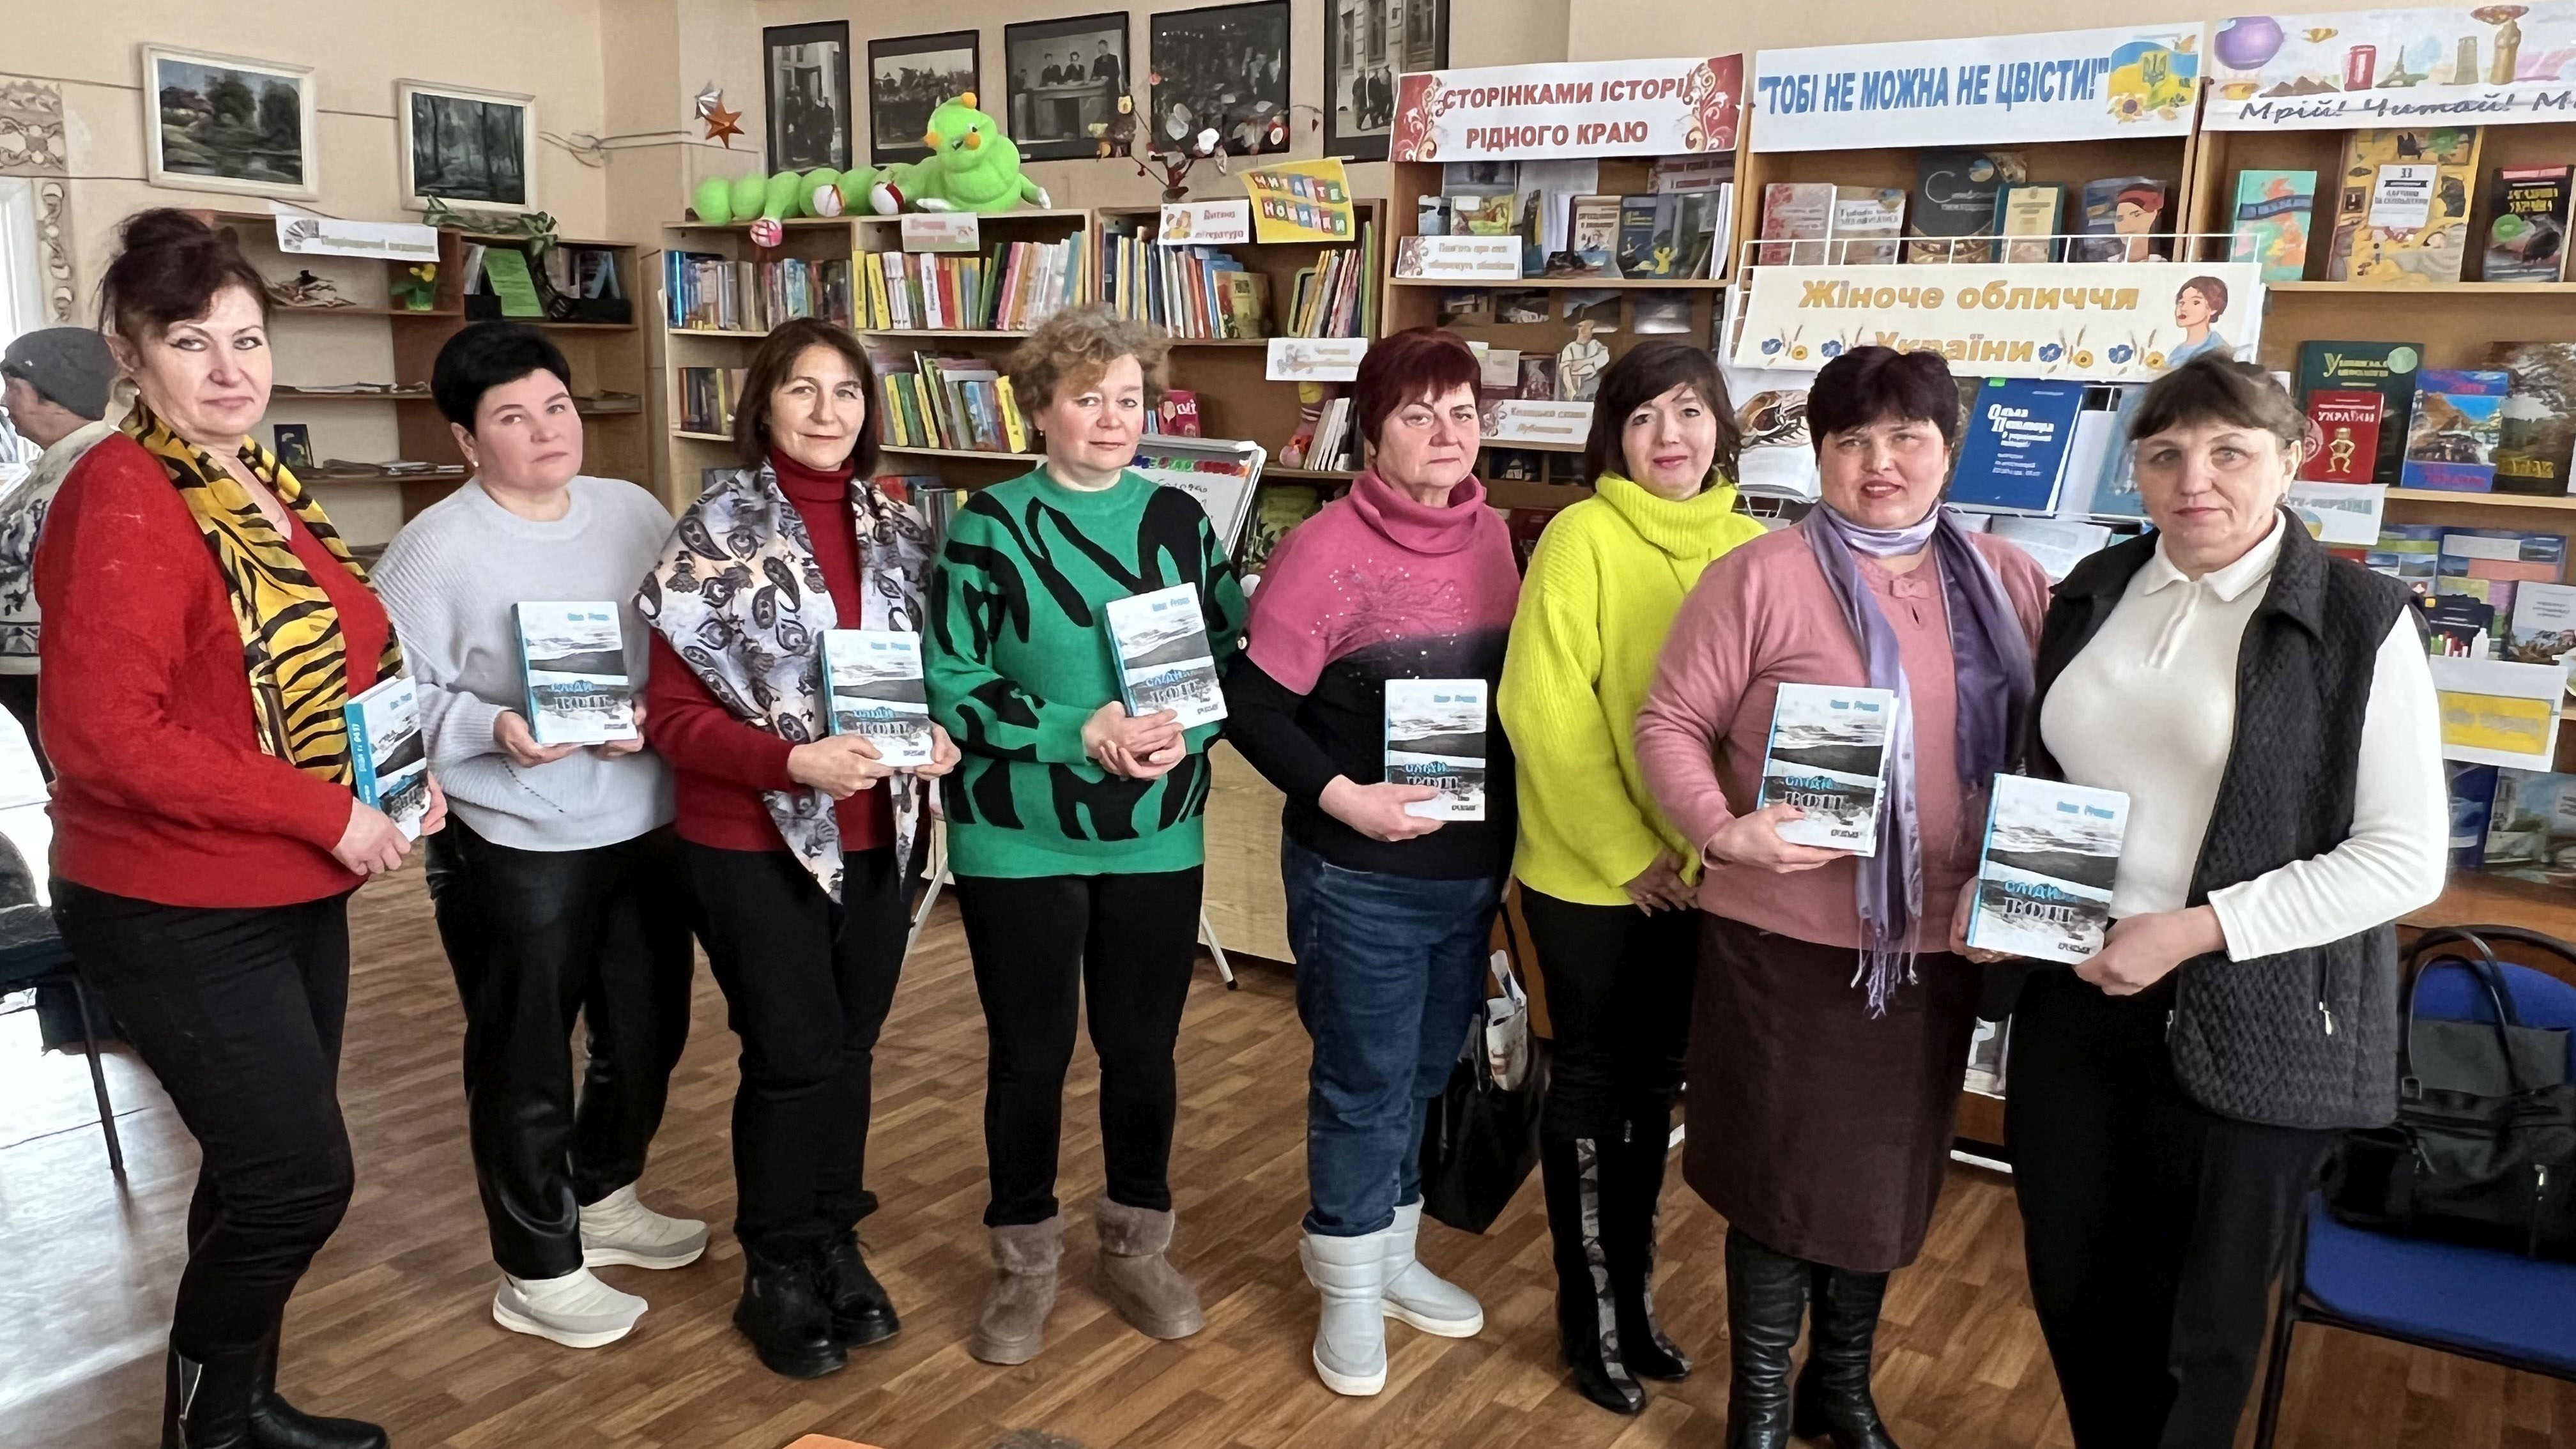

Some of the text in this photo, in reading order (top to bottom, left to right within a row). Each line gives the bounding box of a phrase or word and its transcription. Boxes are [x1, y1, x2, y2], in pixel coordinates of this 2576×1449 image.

[1441, 82, 1592, 110] СТОРІНКАМИ
[1758, 56, 2110, 115] "ТОБІ НЕ МОЖНА НЕ ЦВІСТИ!"
[2532, 91, 2576, 111] М
[1466, 120, 1648, 152] РІДНОГО КРАЮ
[1798, 280, 2138, 310] Жіноче обличчя
